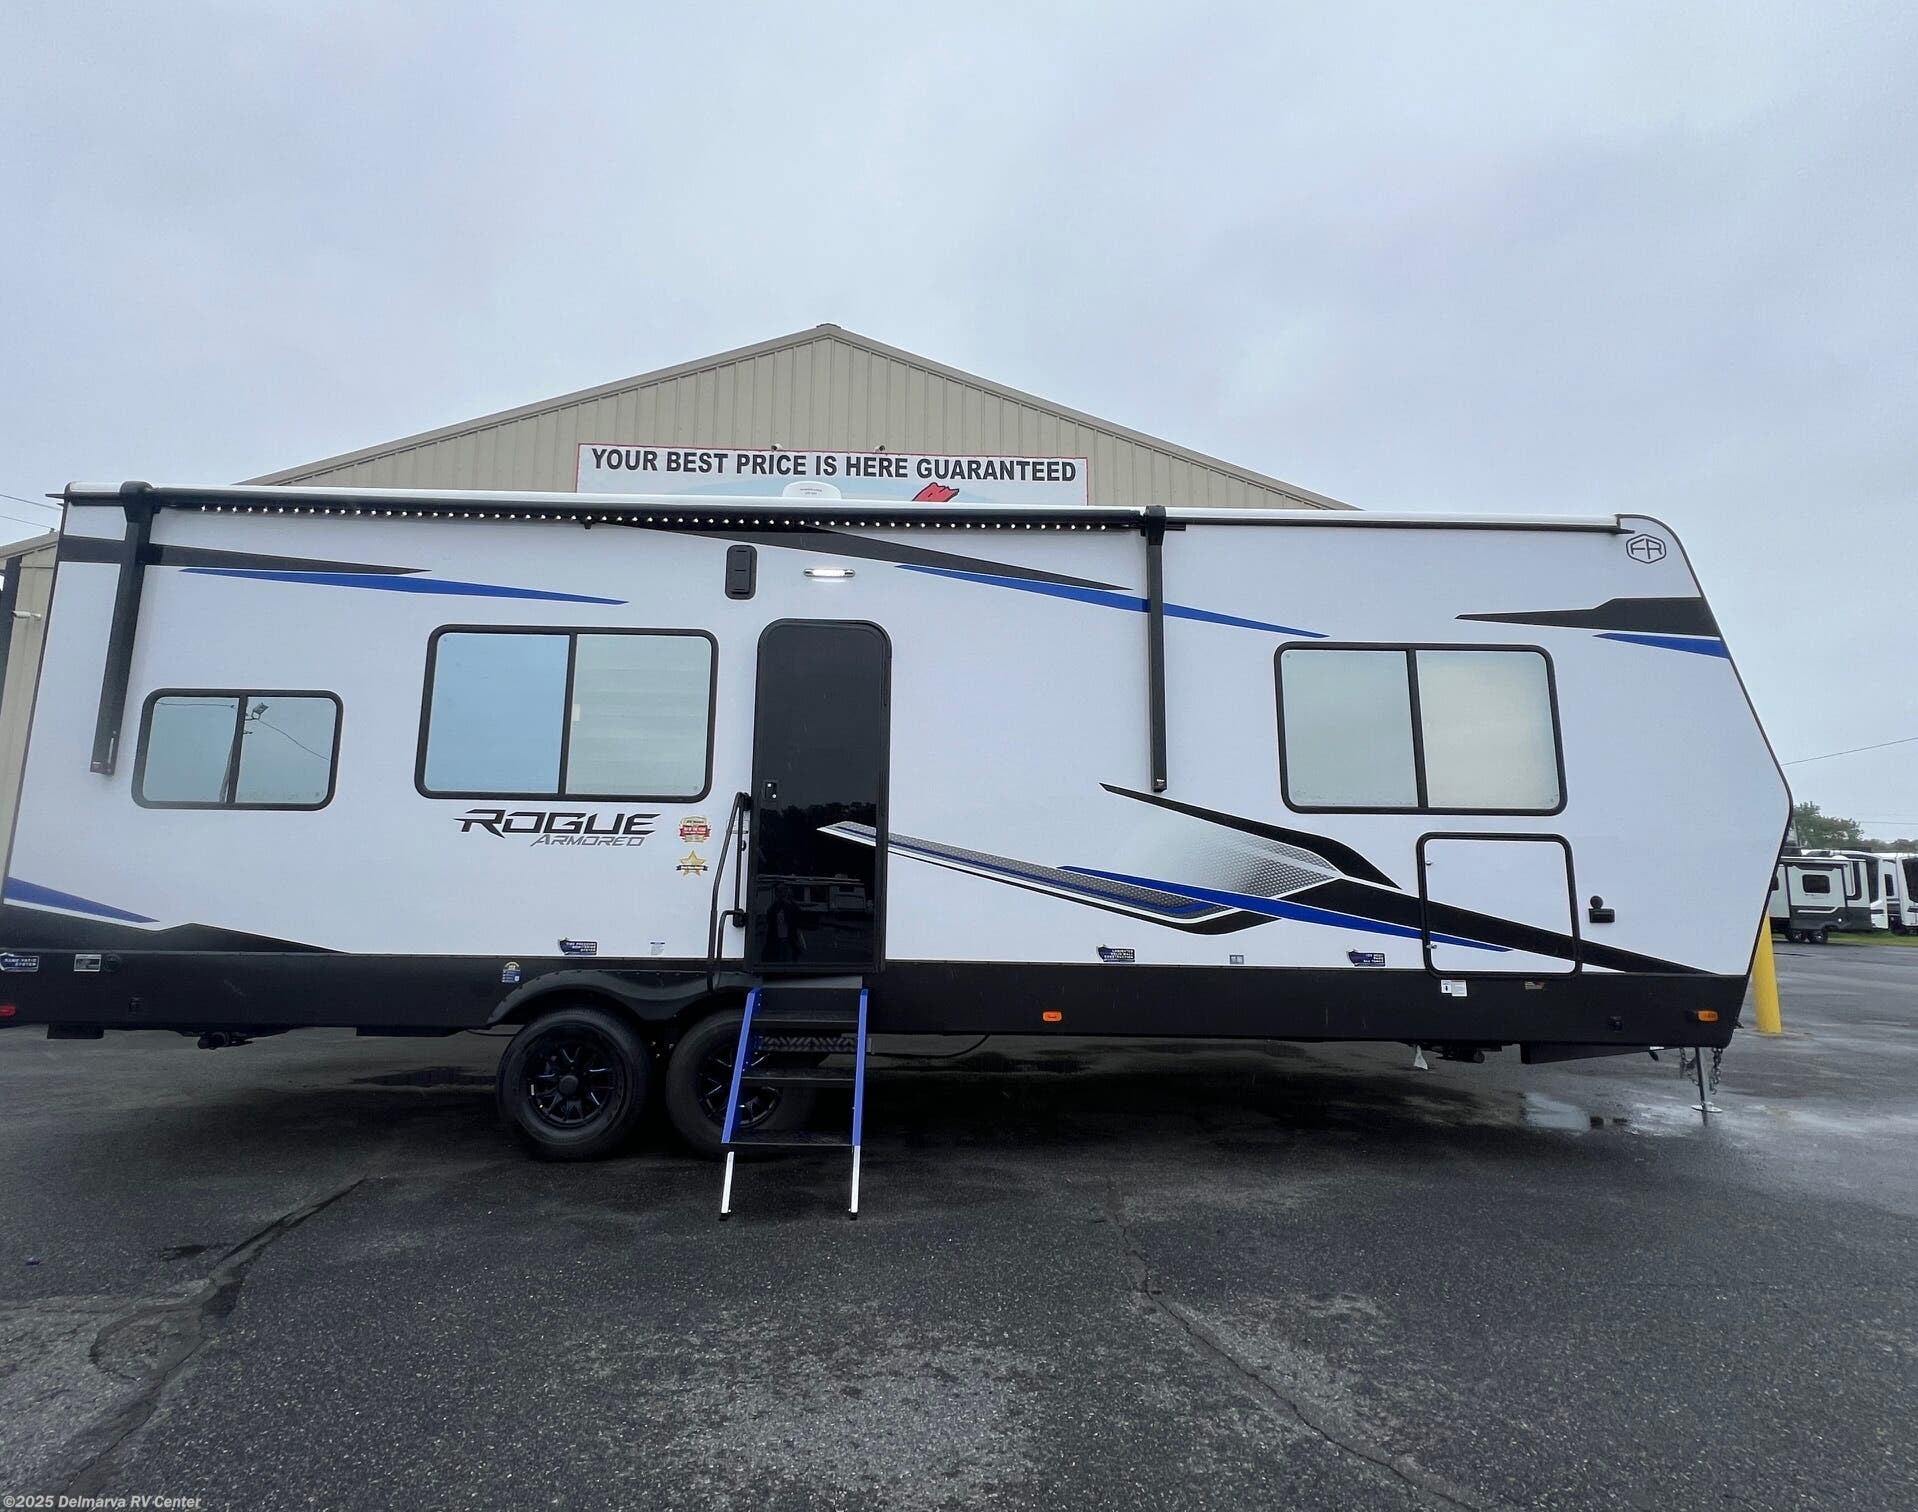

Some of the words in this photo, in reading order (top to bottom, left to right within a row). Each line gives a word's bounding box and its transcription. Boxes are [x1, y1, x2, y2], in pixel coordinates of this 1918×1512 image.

[592, 447, 658, 471] YOUR
[666, 451, 728, 474] BEST
[736, 453, 807, 476] PRICE
[815, 455, 837, 476] IS
[845, 456, 908, 478] HERE
[916, 458, 1077, 482] GUARANTEED
[452, 808, 662, 839] ROGUE
[530, 834, 646, 847] ARMORED
